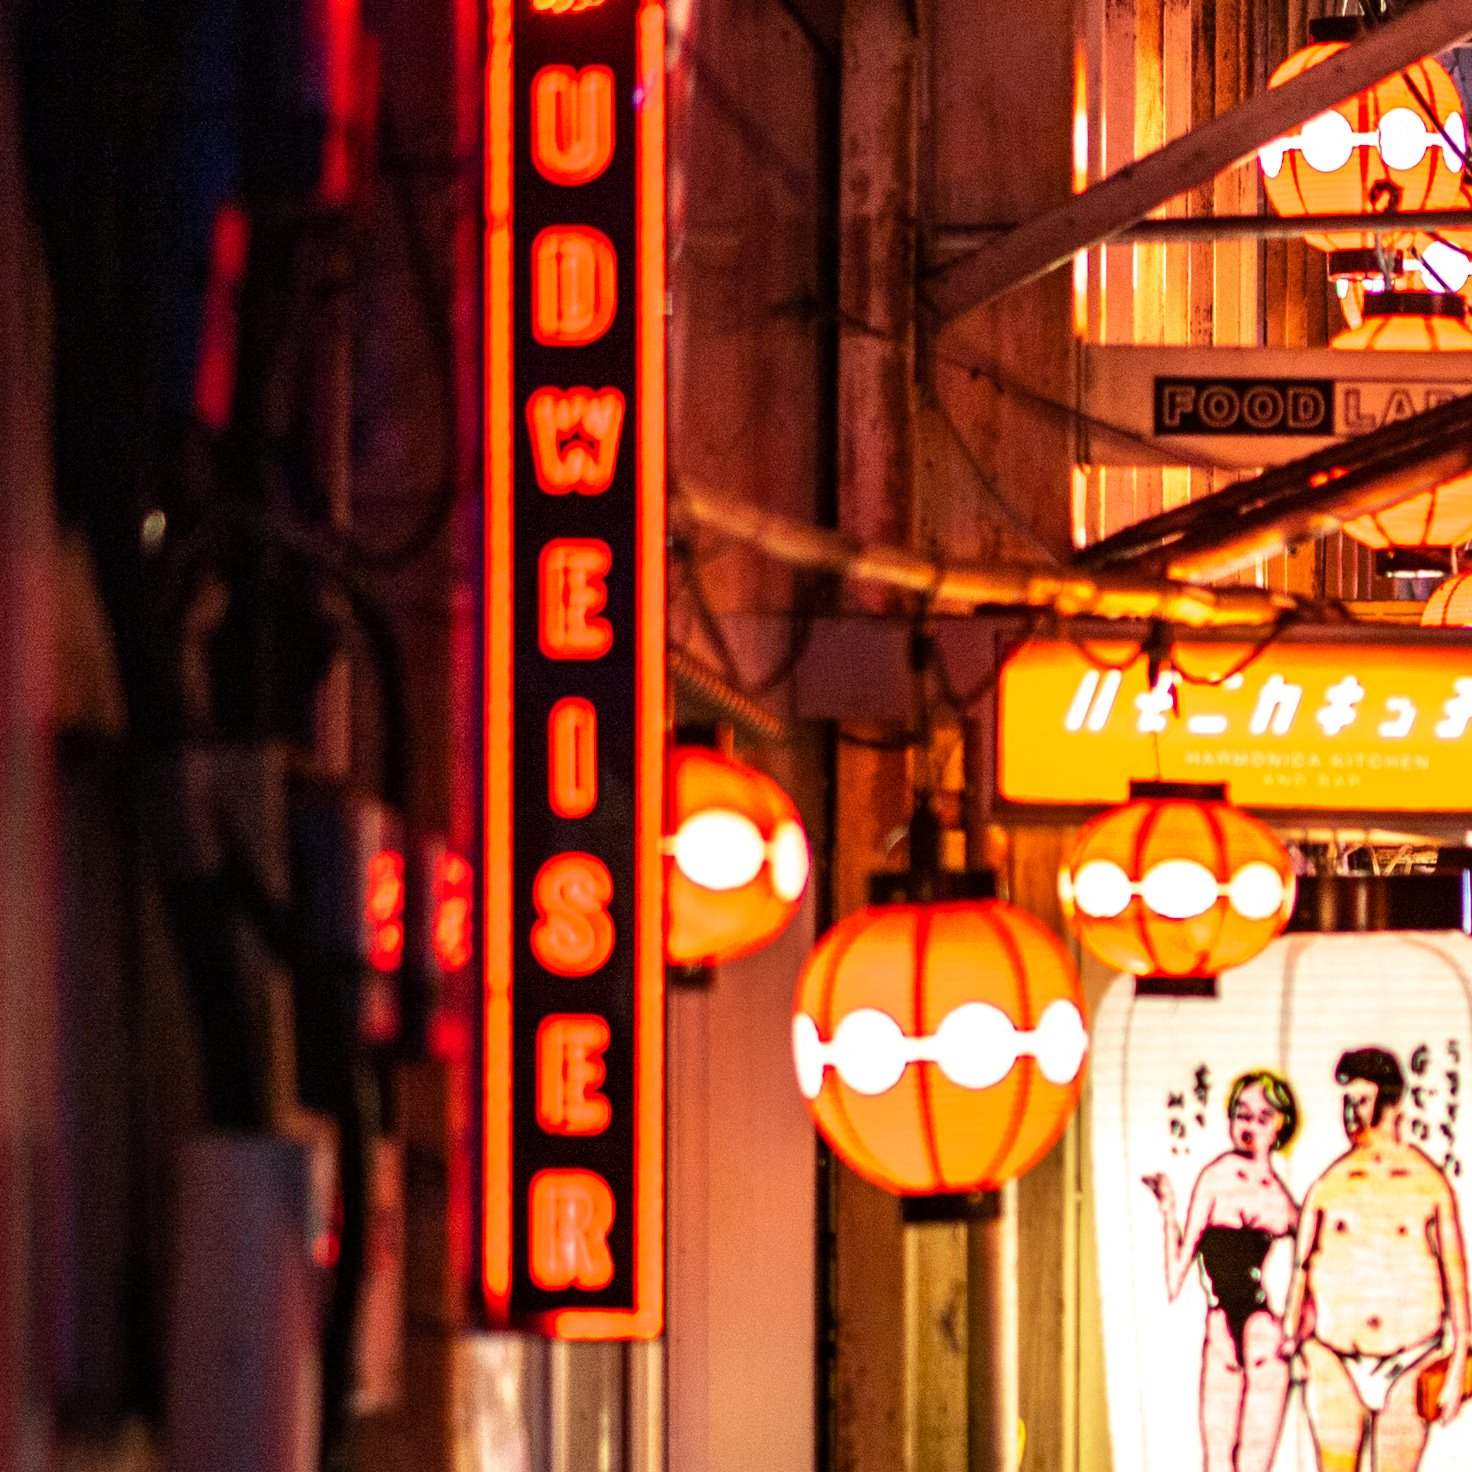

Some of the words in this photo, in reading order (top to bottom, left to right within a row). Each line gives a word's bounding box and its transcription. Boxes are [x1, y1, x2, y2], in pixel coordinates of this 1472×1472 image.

[525, 0, 626, 1290] UDWEISER
[1162, 385, 1326, 428] FOOD
[1343, 388, 1457, 427] LA
